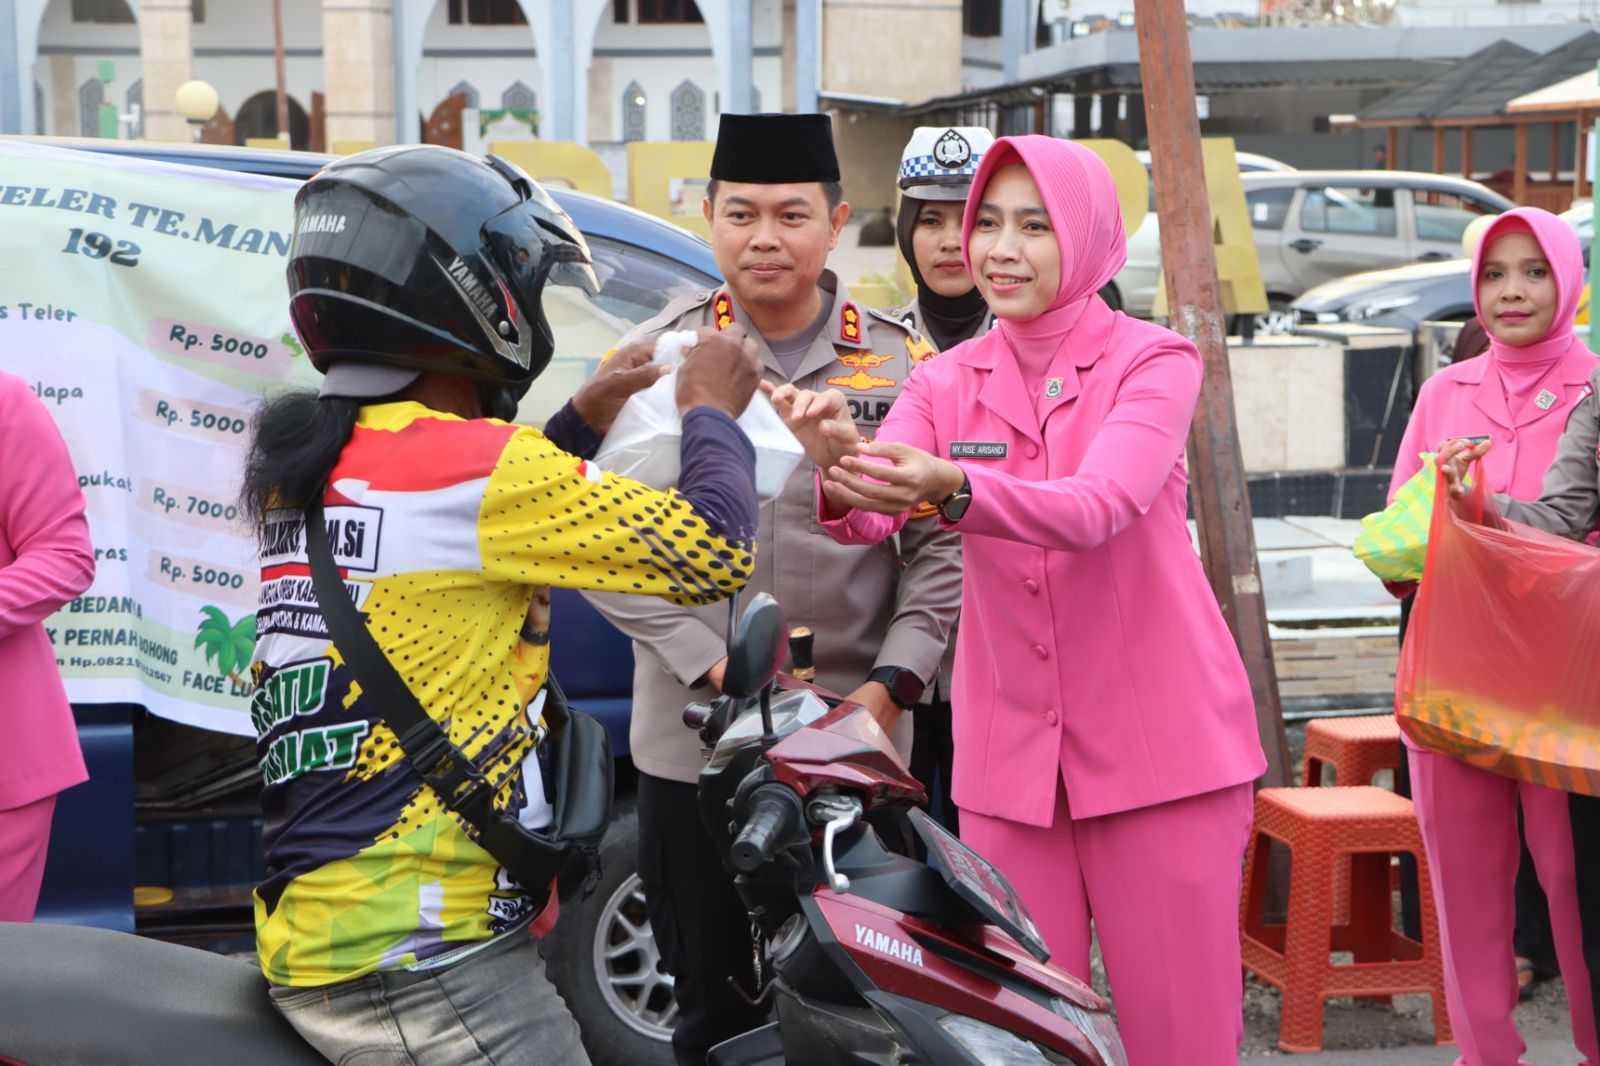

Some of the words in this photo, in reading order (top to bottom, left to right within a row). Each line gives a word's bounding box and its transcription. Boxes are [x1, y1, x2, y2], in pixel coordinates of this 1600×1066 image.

[0, 186, 117, 219] ELER
[298, 215, 346, 234] YAMAHA
[61, 228, 142, 267] 192
[448, 256, 499, 317] YAMAHA
[18, 303, 77, 322] Teler
[169, 324, 203, 351] Rp.
[211, 334, 268, 359] 5000
[30, 381, 84, 405] lapa
[156, 400, 183, 426] Rp.
[190, 409, 245, 433] 5000
[962, 445, 976, 454] RISE
[153, 487, 180, 513] Rp.
[187, 496, 237, 520] 7000
[160, 556, 186, 582] Rp.
[192, 565, 244, 589] 5000
[64, 628, 138, 647] PERNAH
[182, 669, 226, 694] FACE
[855, 923, 924, 967] YAMAHA
